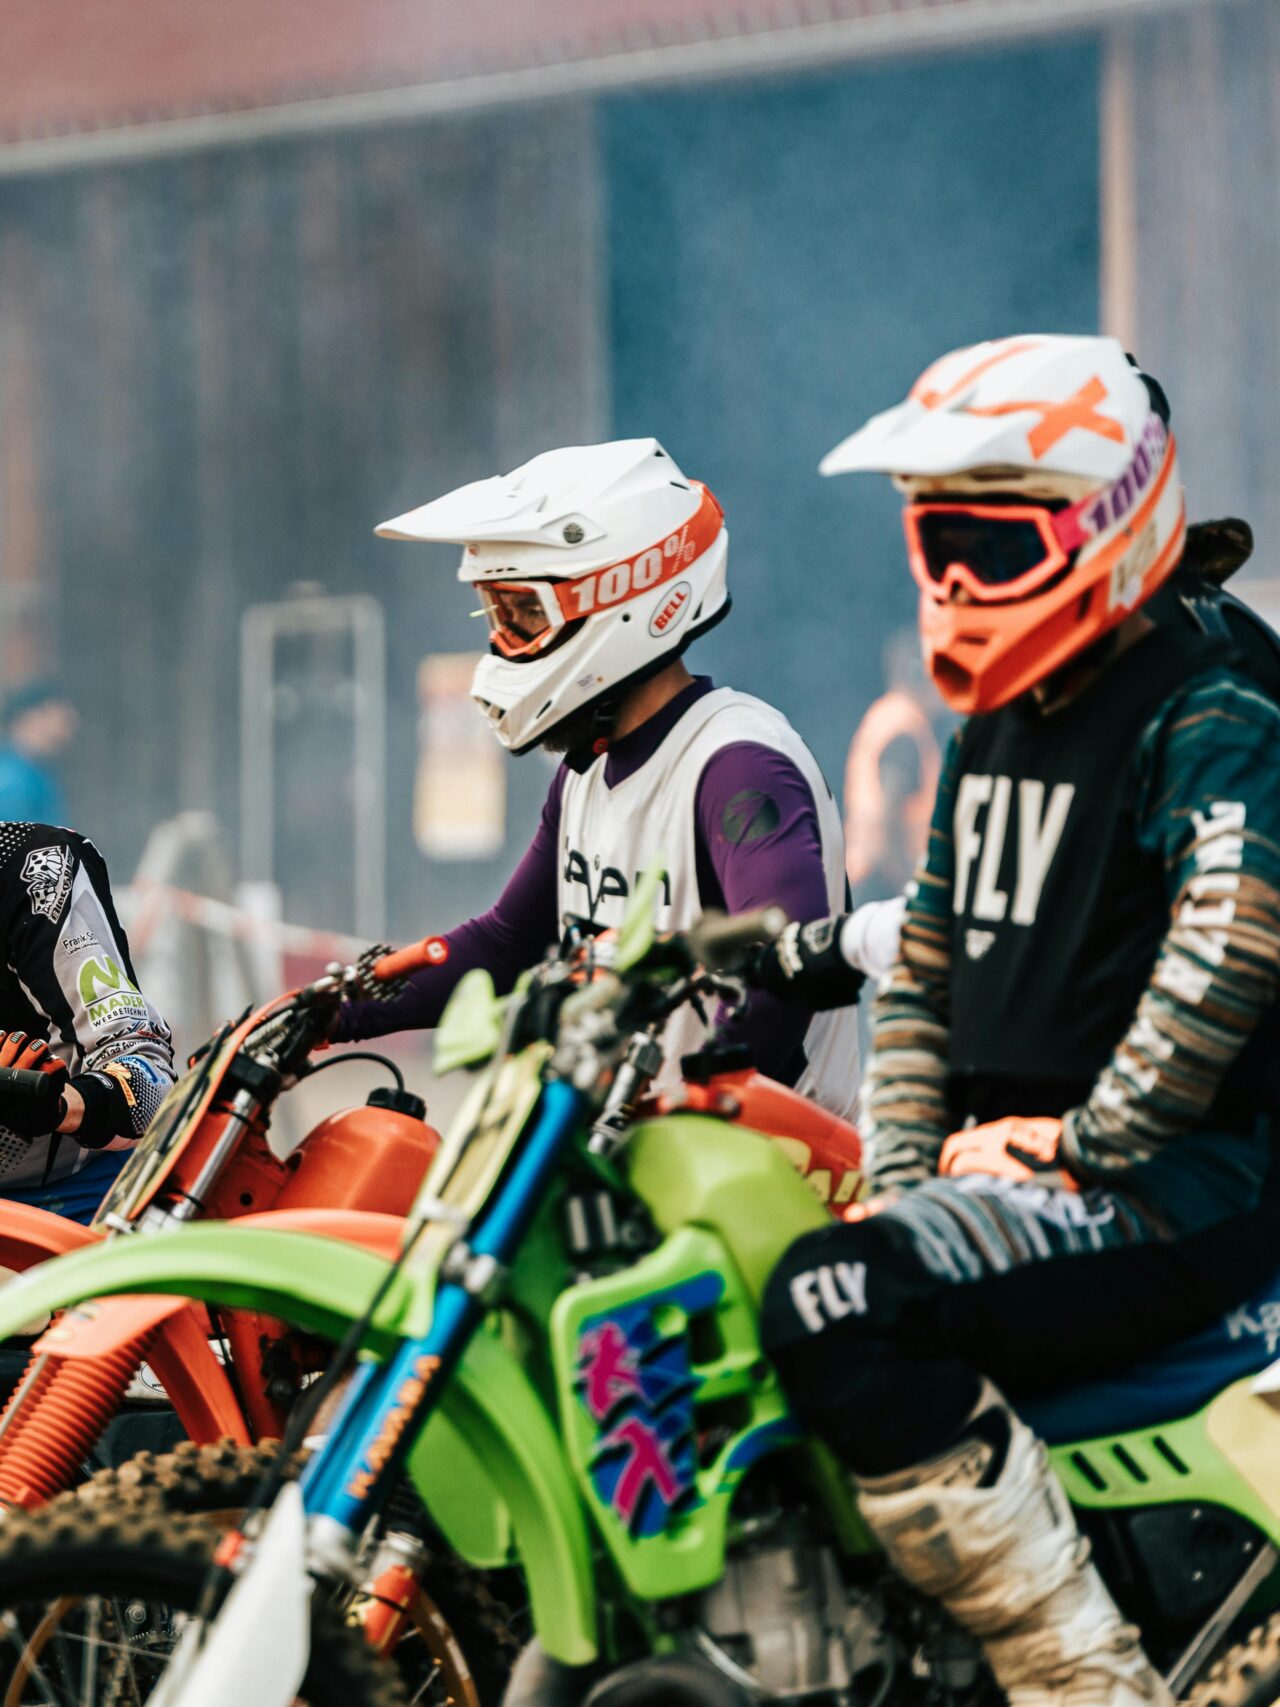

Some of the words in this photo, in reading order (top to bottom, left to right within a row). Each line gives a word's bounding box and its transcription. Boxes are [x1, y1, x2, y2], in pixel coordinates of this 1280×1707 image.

[571, 525, 696, 613] 100%
[654, 592, 687, 630] BELL
[953, 773, 1075, 926] FLY
[63, 935, 87, 950] Frank
[89, 996, 145, 1021] MADER
[789, 1262, 867, 1333] FLY
